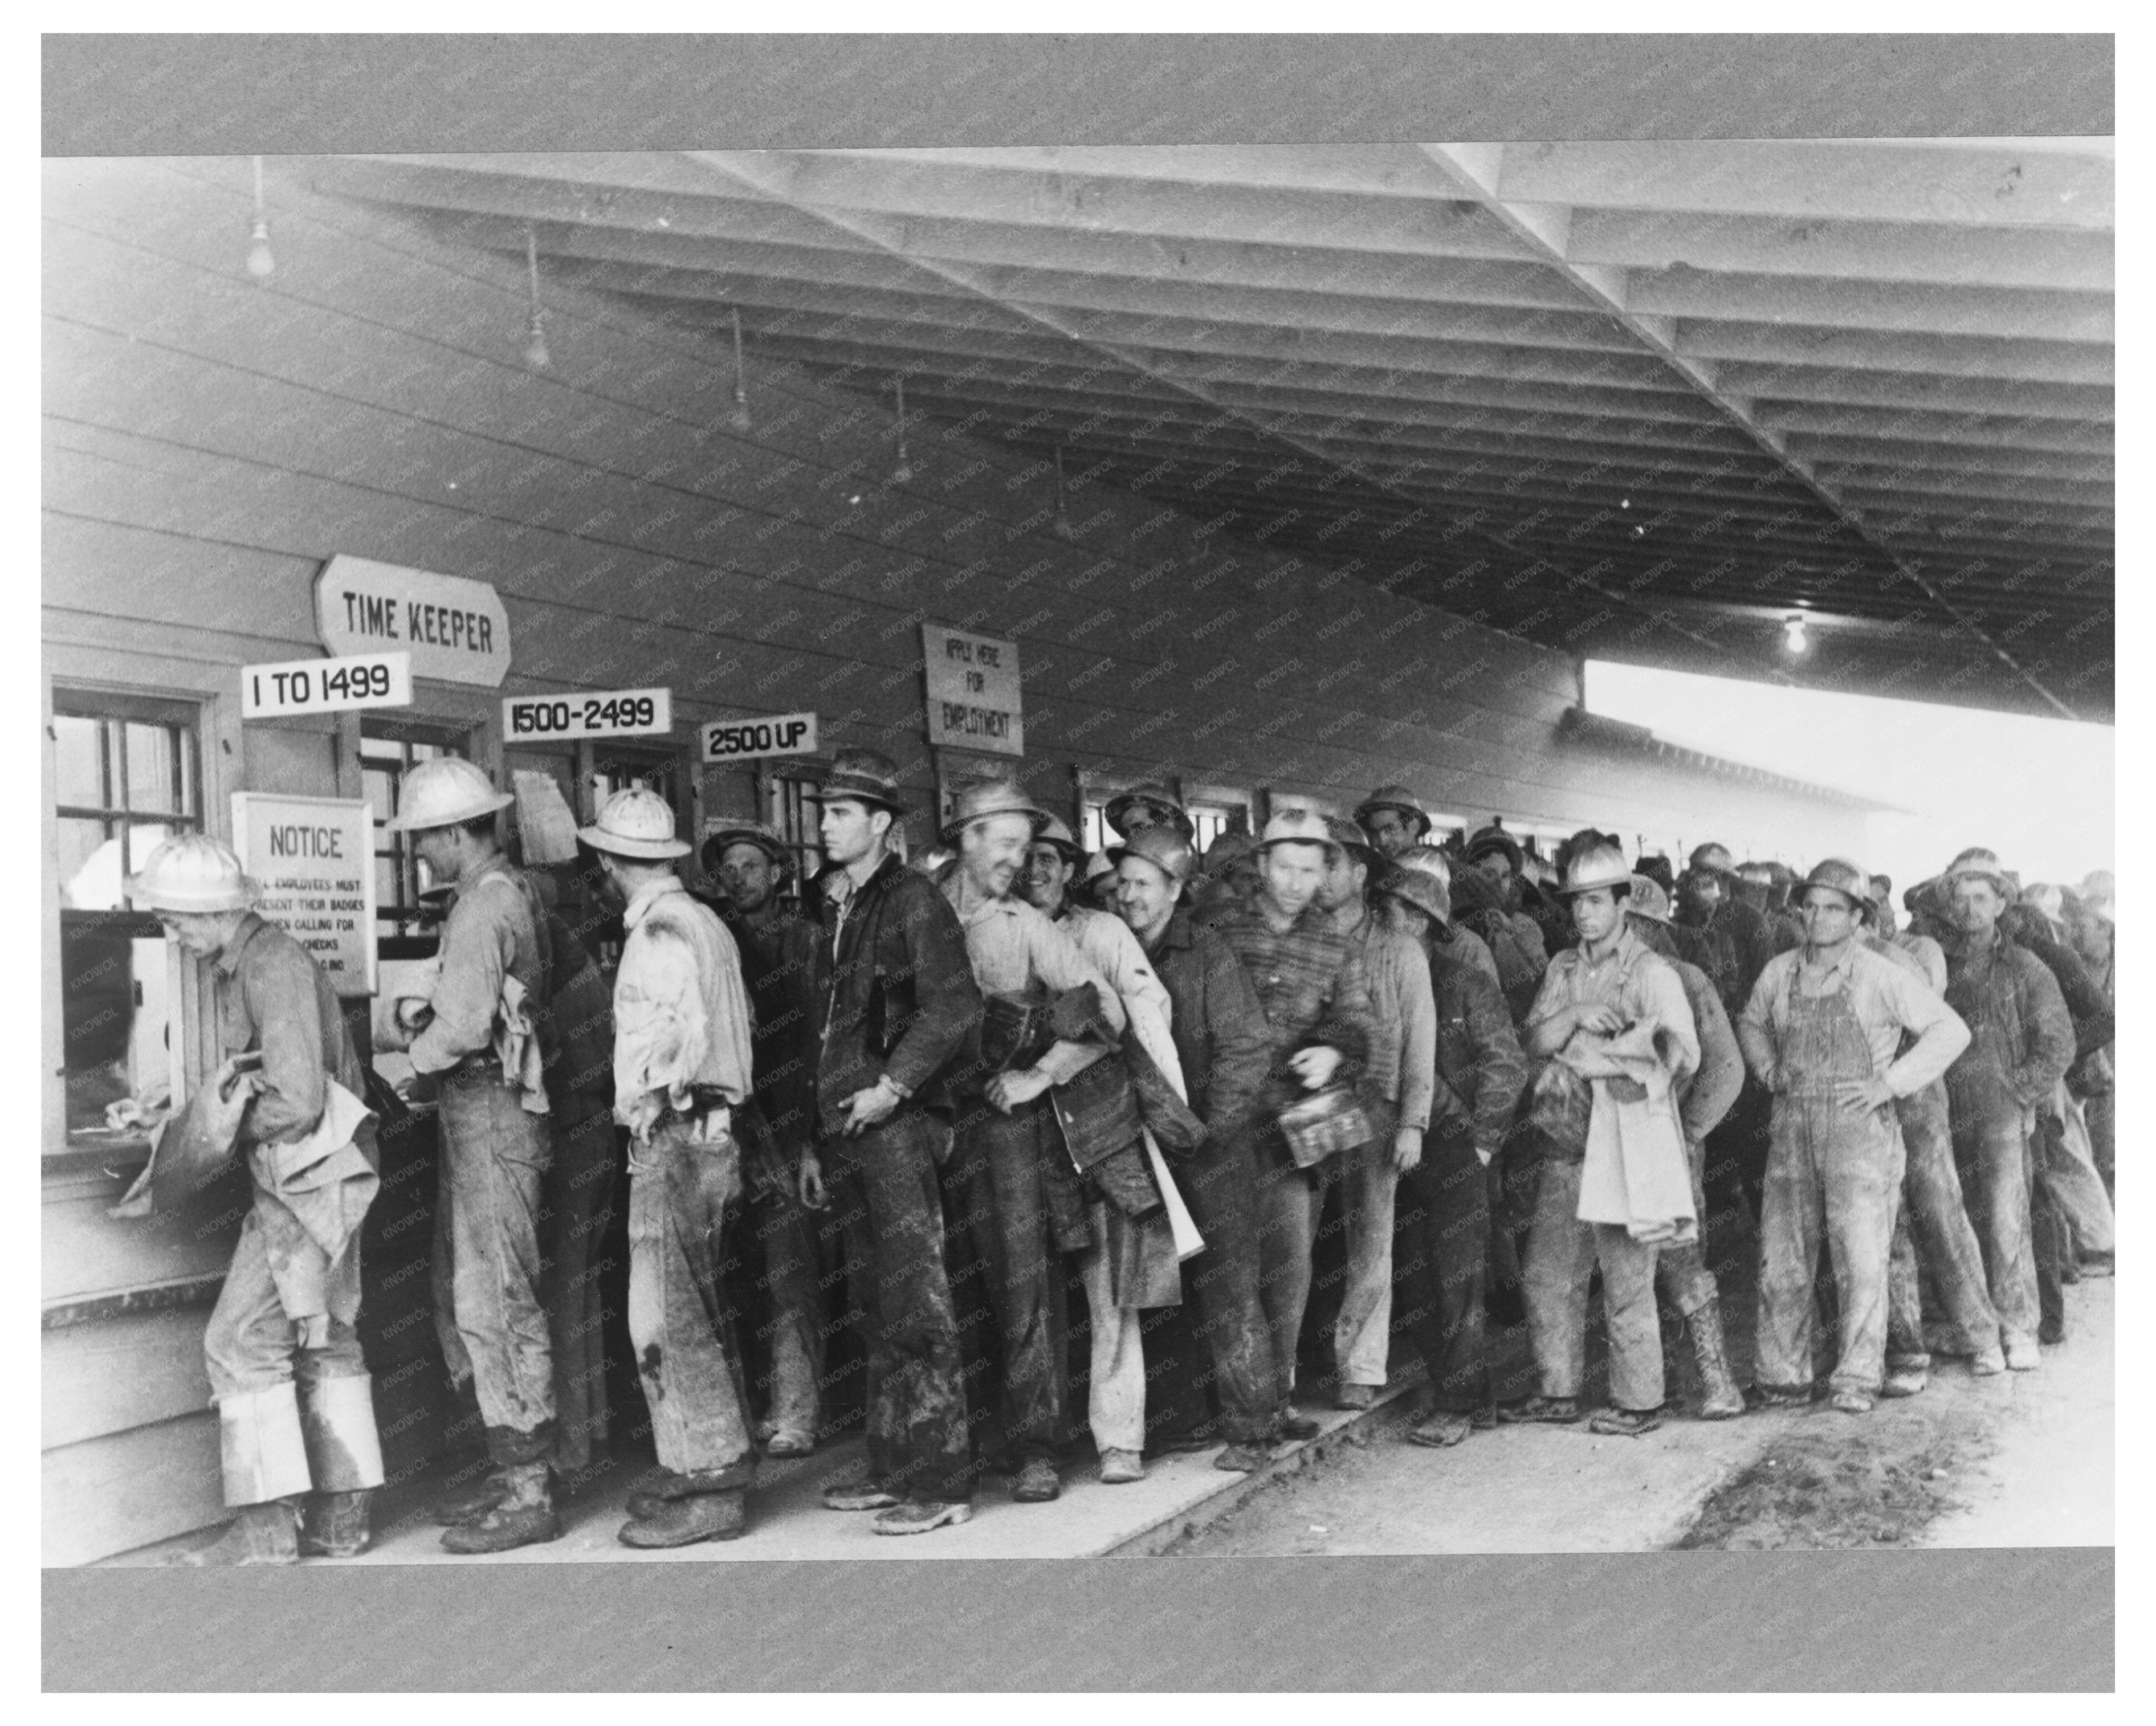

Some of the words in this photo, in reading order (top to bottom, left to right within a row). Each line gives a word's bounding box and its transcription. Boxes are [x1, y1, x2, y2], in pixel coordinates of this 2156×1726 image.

[343, 591, 398, 639] TIME
[409, 602, 492, 653] KEEPER
[272, 671, 309, 704] TO
[322, 664, 390, 701] 1499
[512, 697, 654, 732] 1500-2499
[943, 703, 1009, 740] EMPLOYMENT
[709, 724, 771, 756] 2500
[776, 721, 808, 748] UP
[270, 825, 343, 858] NOTICE
[275, 878, 331, 891] EMPLOYEES
[336, 879, 360, 892] MUST
[252, 899, 292, 911] RESENT
[299, 899, 325, 911] THEIR
[330, 899, 365, 911] BADGES
[294, 919, 332, 931] CALLING
[336, 919, 354, 931] FOR
[303, 939, 339, 951] CHECKS
